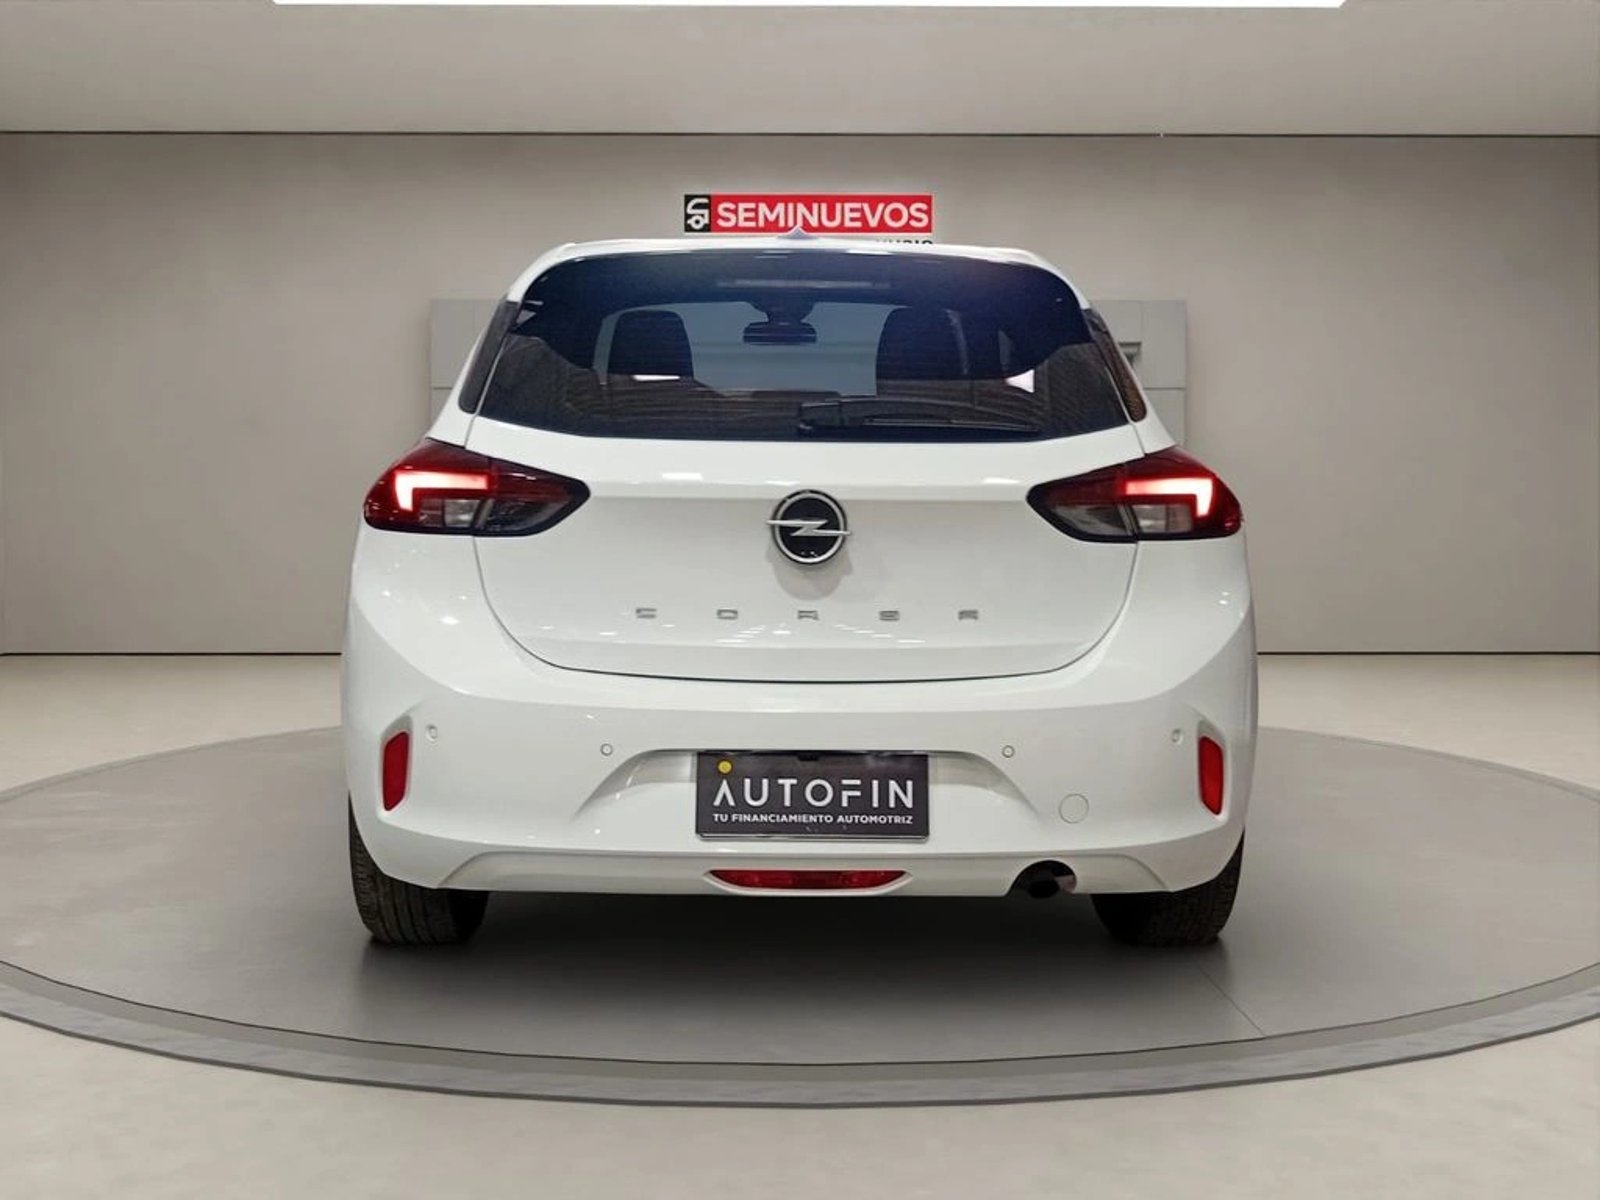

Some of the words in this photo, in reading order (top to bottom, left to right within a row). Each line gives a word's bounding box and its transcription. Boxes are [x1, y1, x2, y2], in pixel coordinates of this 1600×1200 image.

[716, 201, 929, 228] SEMINUEVOS
[713, 778, 914, 809] AUTOFIN
[713, 813, 728, 823] TU
[731, 813, 834, 824] FINANCIAMIENTO
[837, 814, 914, 825] AUTOMOTRIZ
